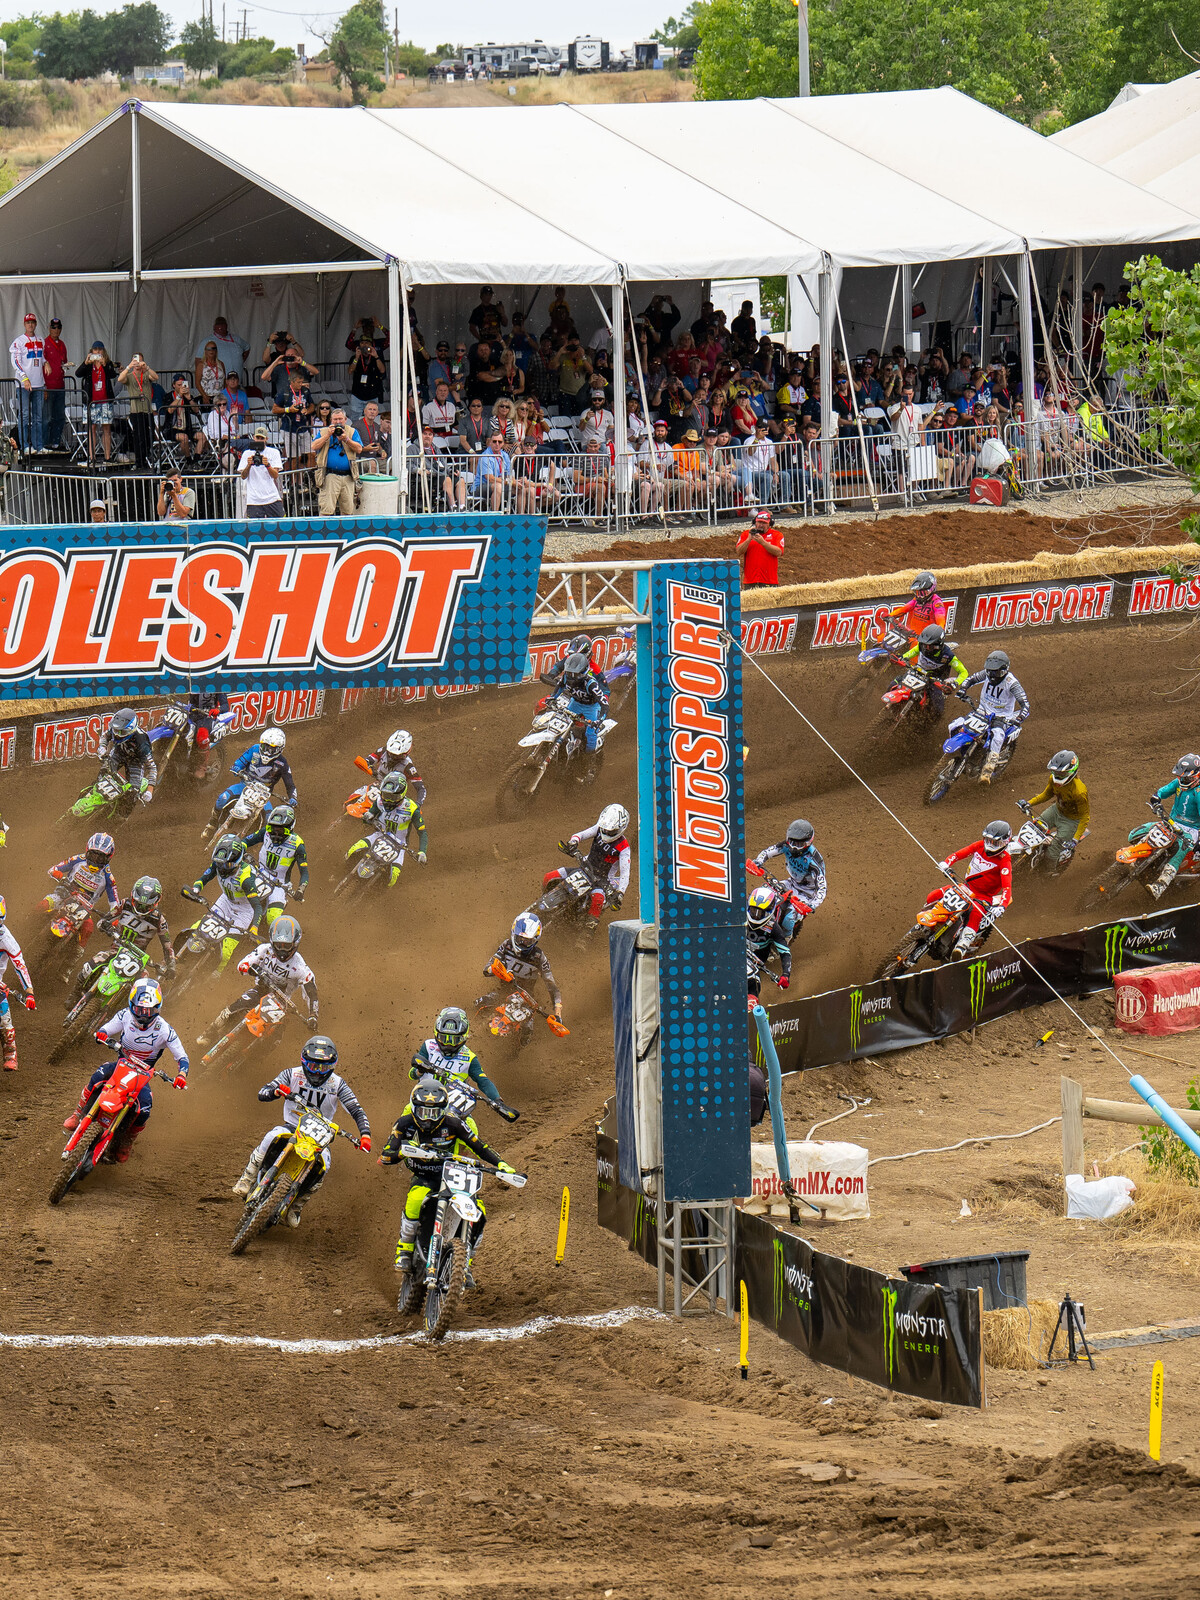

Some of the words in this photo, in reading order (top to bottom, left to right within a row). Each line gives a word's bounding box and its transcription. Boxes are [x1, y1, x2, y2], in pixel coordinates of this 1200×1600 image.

[986, 684, 1003, 699] FLY
[164, 708, 187, 726] 376
[120, 913, 151, 936] FOX
[201, 918, 228, 940] 59
[1132, 944, 1169, 956] ENERGY
[113, 954, 140, 977] 30
[992, 979, 1014, 992] ENERGY
[864, 1015, 886, 1025] ENERGY
[120, 1070, 137, 1086] 1
[297, 1087, 328, 1109] FLY
[300, 1118, 333, 1147] 331
[448, 1169, 478, 1197] 31
